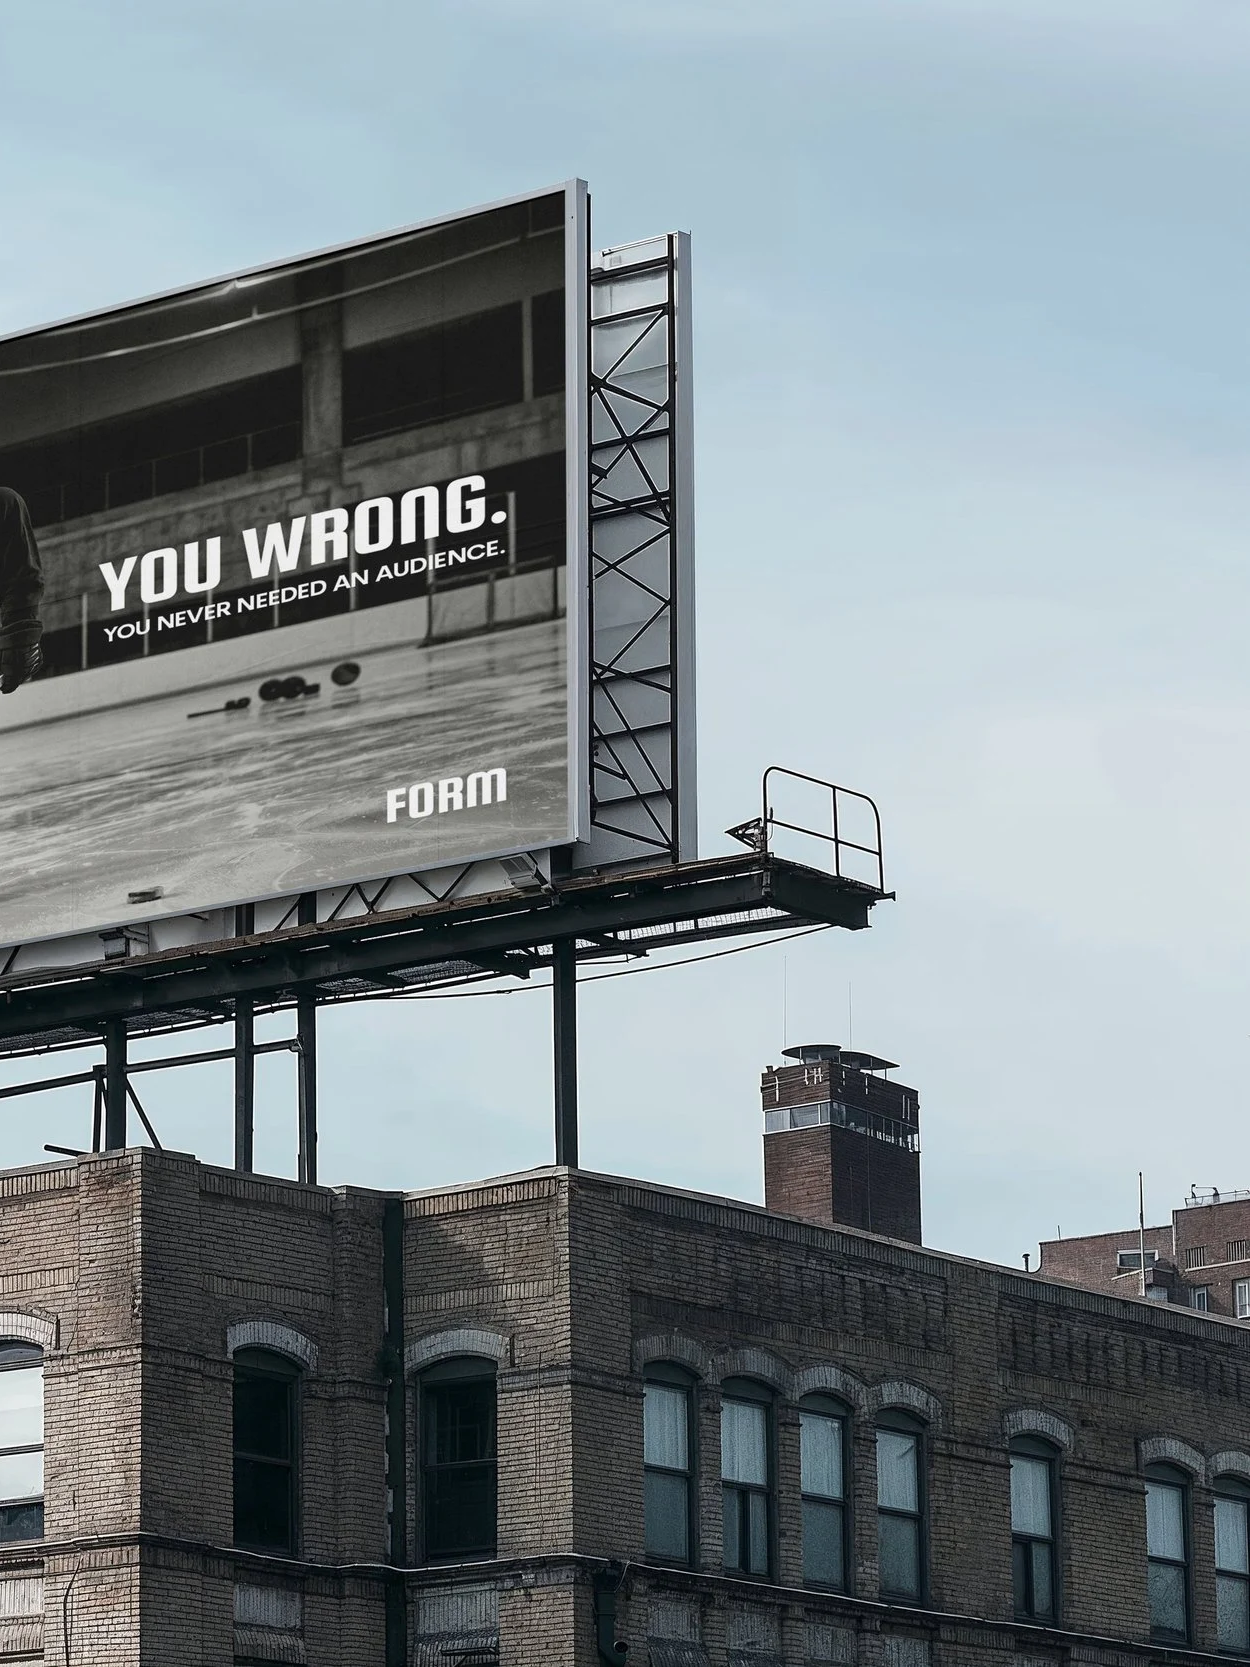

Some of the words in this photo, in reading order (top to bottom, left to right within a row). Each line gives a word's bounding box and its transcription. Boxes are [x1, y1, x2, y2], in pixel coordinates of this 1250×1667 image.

[99, 536, 221, 611] YOU
[242, 475, 507, 579] WRONG.
[103, 619, 150, 642] YOU
[157, 601, 231, 631] NEVER
[237, 580, 326, 613] NEEDED
[333, 570, 368, 592] AN
[375, 540, 506, 582] AUDIENCE.
[387, 768, 507, 823] FORM
